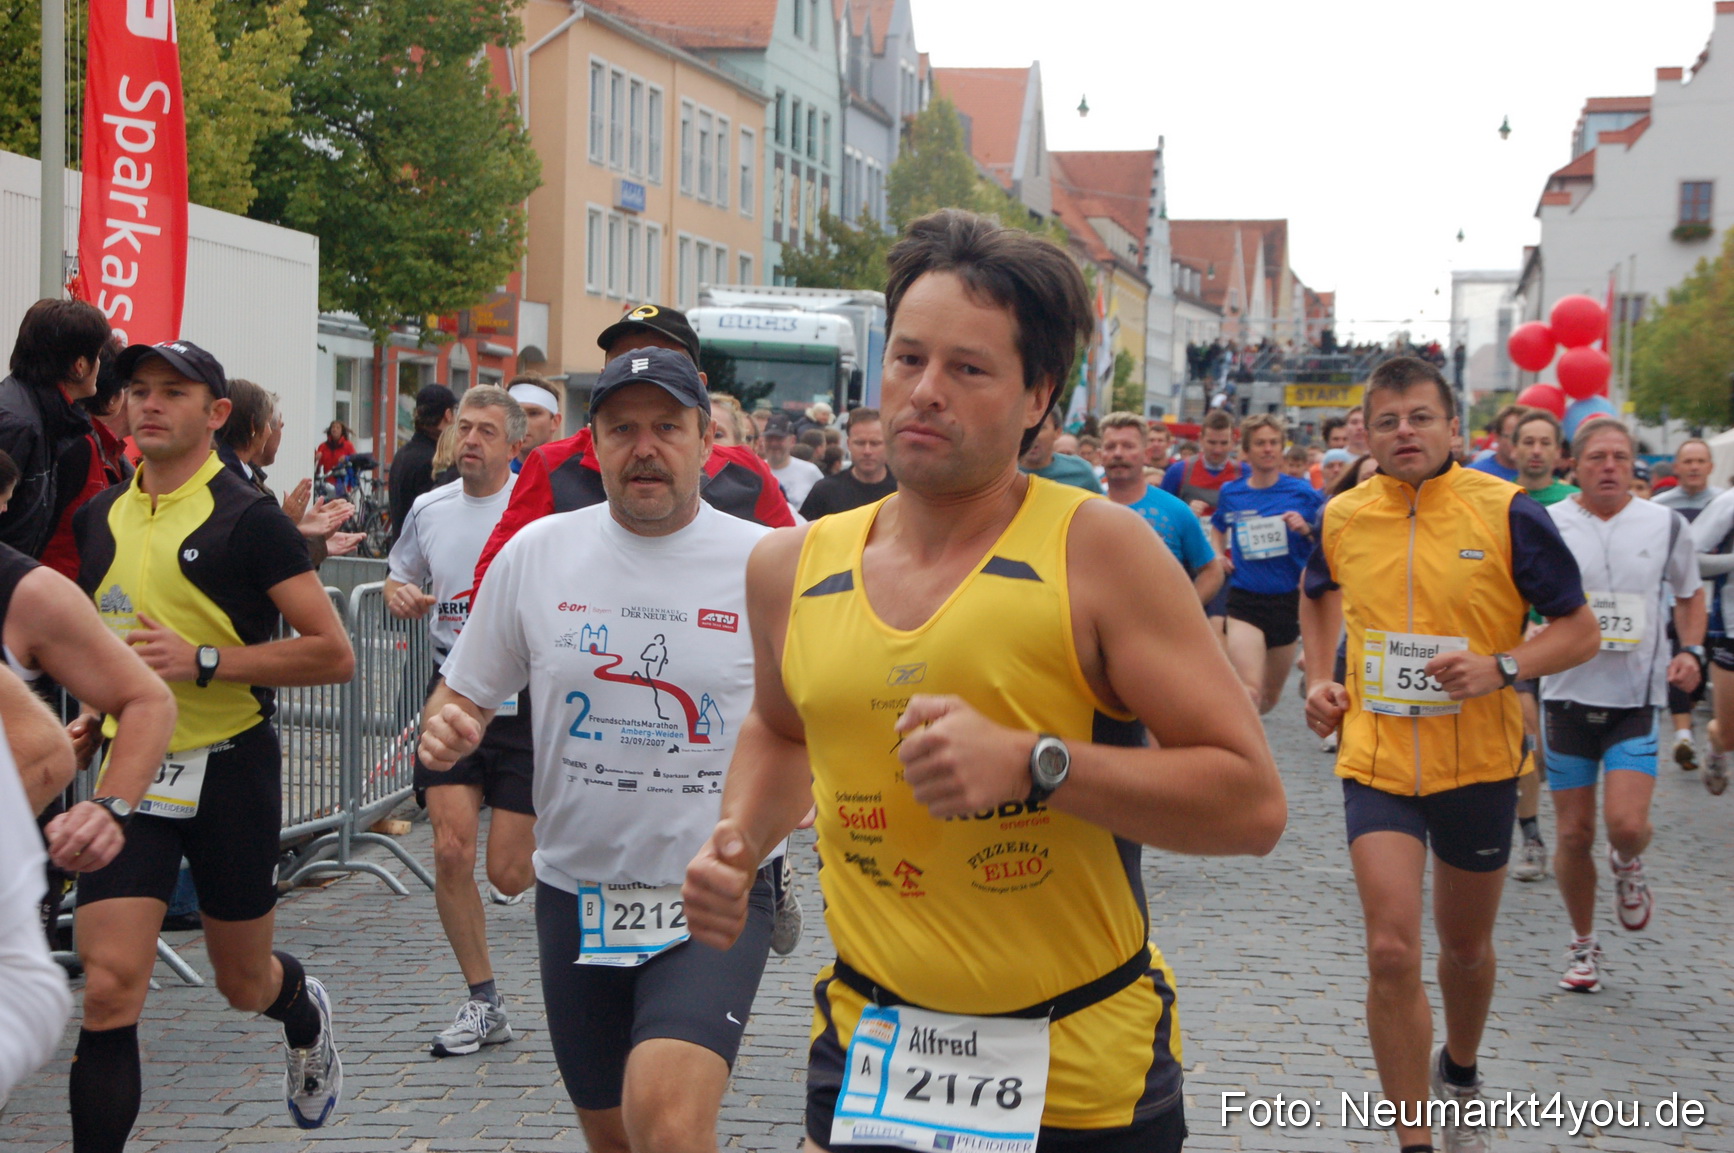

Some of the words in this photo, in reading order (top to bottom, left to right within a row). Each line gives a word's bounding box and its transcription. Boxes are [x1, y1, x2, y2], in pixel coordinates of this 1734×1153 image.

[1295, 387, 1351, 401] START
[621, 607, 641, 619] DER
[643, 612, 668, 621] NEUE
[631, 605, 680, 615] MEDIENHAUS
[701, 613, 735, 625] ATU
[1389, 640, 1439, 659] Michael
[1366, 661, 1372, 674] B
[565, 690, 603, 742] 2.
[620, 727, 685, 740] Amberg-Weiden
[620, 736, 666, 747] 23/09/2007
[562, 757, 588, 770] SIEMENS
[682, 785, 704, 794] DAK
[152, 801, 196, 814] PFLEIDERER
[838, 805, 887, 829] Seidl
[967, 841, 1050, 870] PIZZERIA
[982, 856, 1043, 883] ELIO
[586, 901, 594, 916] B
[612, 901, 687, 930] 2212
[908, 1025, 978, 1057] Alfred
[861, 1054, 872, 1076] A
[904, 1065, 1024, 1110] 2178
[956, 1135, 1032, 1153] PFLEIDERER
